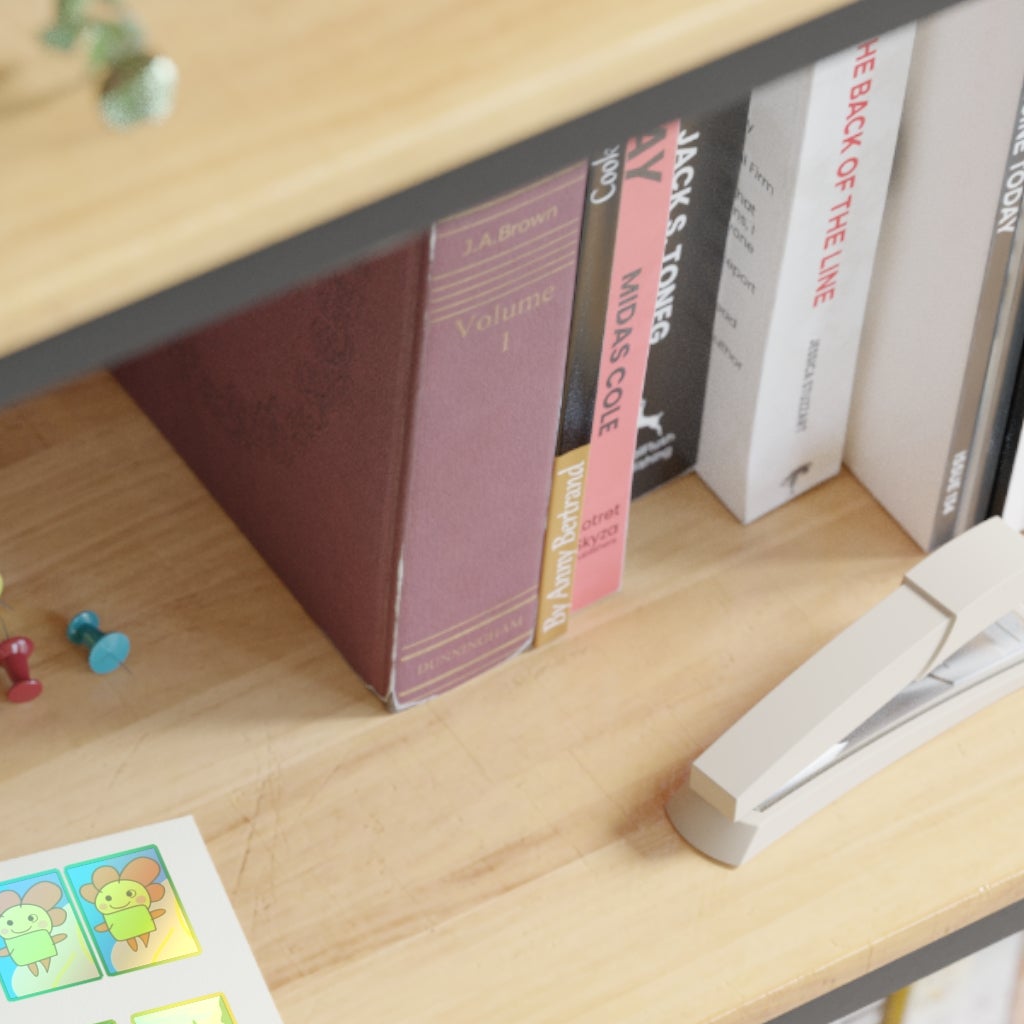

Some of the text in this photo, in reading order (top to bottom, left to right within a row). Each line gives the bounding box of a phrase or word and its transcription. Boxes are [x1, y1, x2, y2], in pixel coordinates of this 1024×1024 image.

[840, 79, 872, 154] BACK
[590, 144, 620, 204] Cook
[669, 129, 700, 211] JACK
[835, 156, 859, 191] OF
[996, 160, 1024, 235] TODAY
[824, 194, 853, 251] THE
[812, 250, 842, 309] LINE
[455, 285, 556, 337] Volume
[598, 267, 643, 437] MIDAS COLE
[551, 460, 585, 550] Bertrand
[542, 603, 571, 633] By
